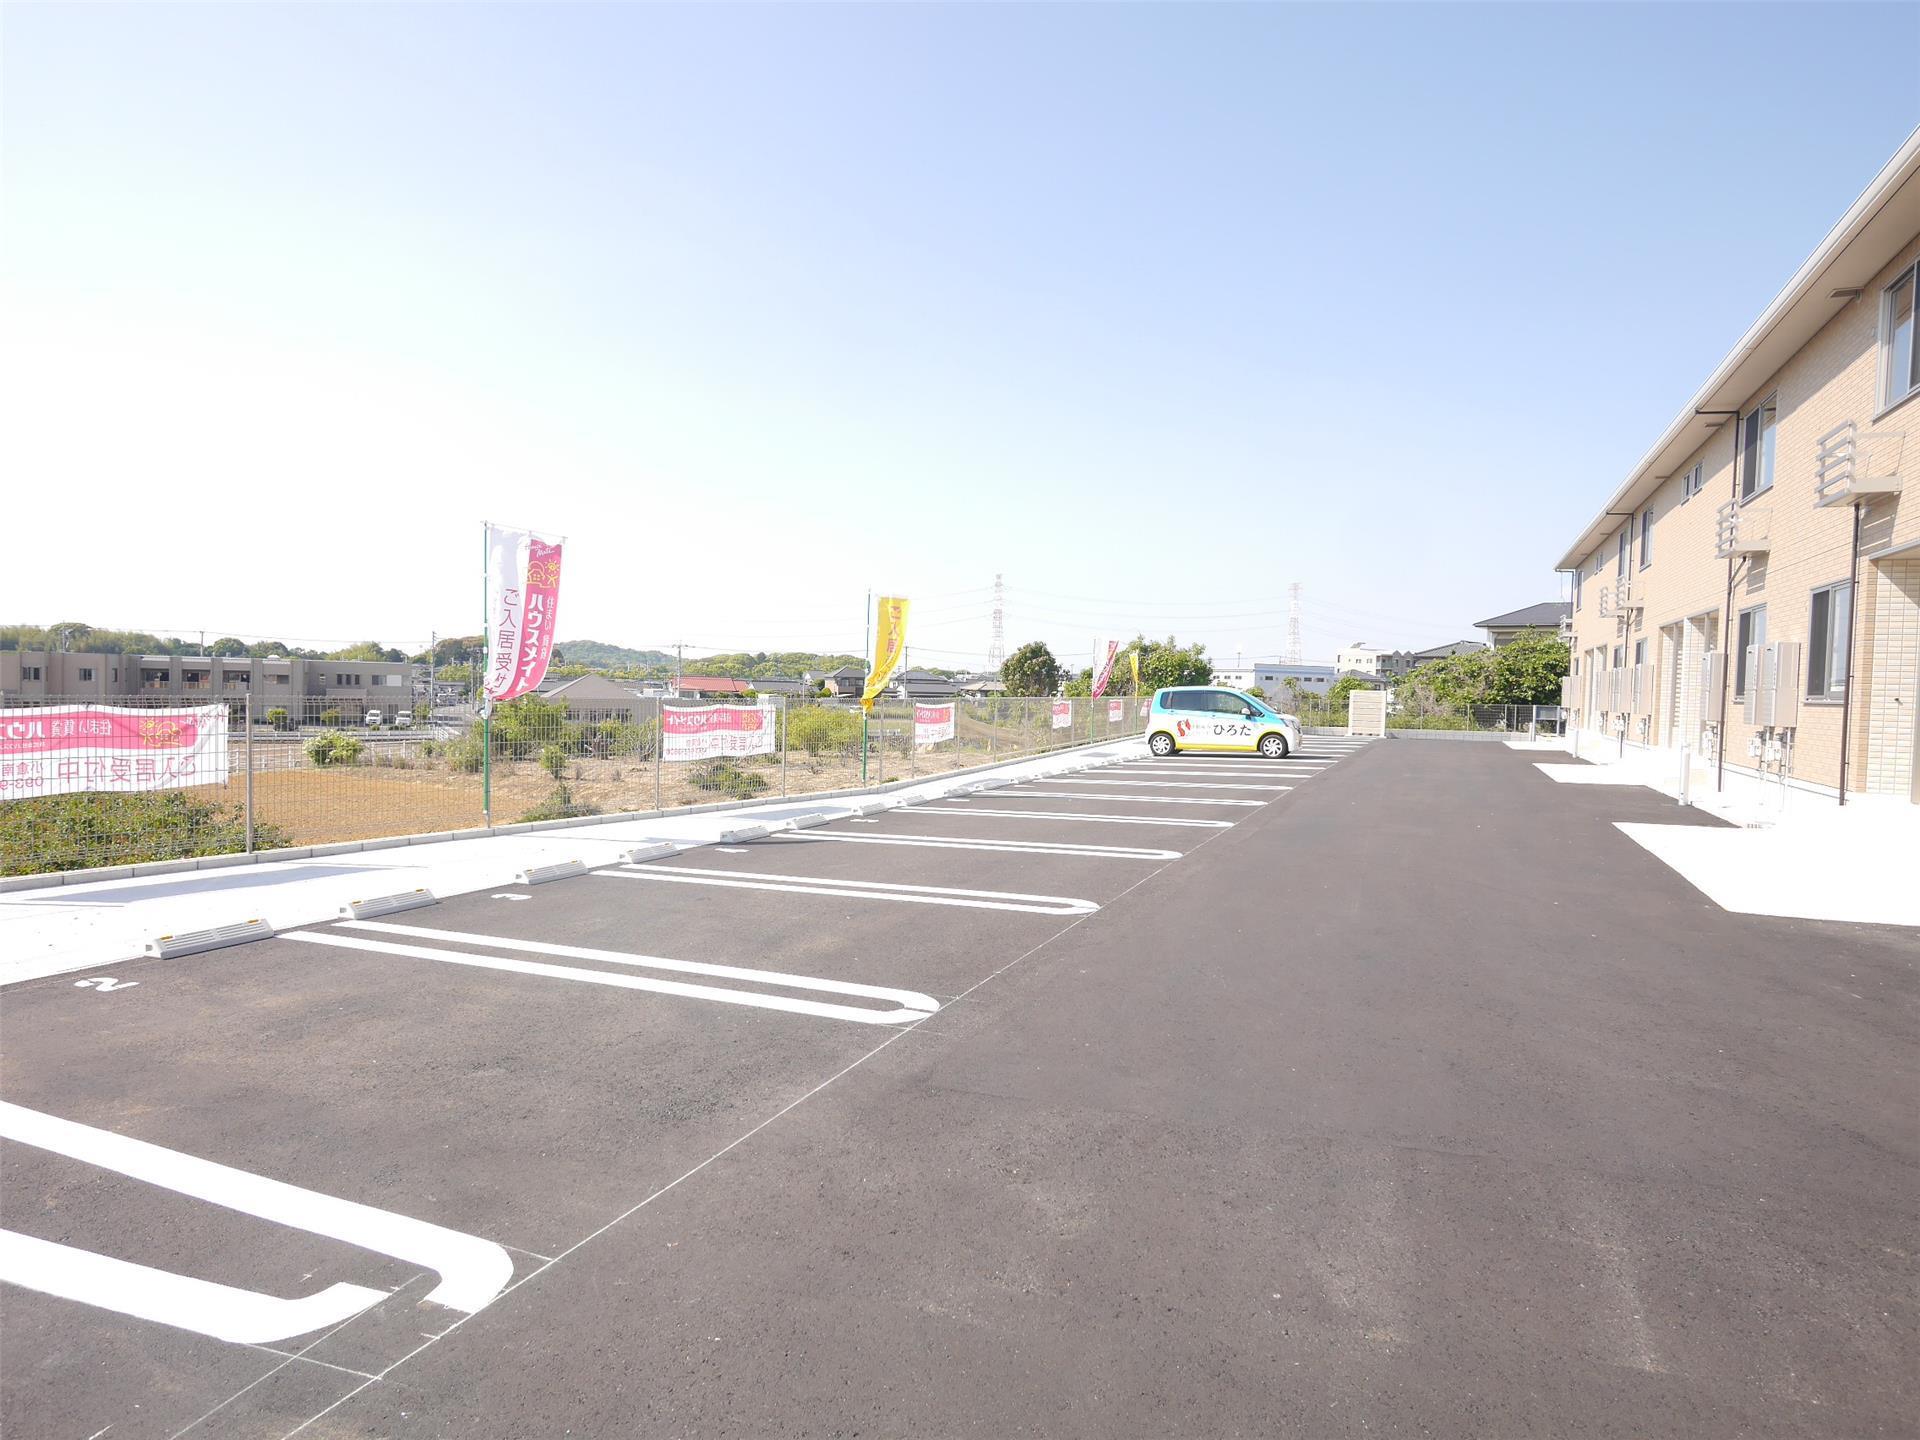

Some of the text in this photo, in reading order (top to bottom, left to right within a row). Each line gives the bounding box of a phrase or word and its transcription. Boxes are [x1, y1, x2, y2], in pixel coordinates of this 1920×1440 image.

[514, 593, 545, 692] ハウスメイト
[1213, 724, 1252, 736] ひろた
